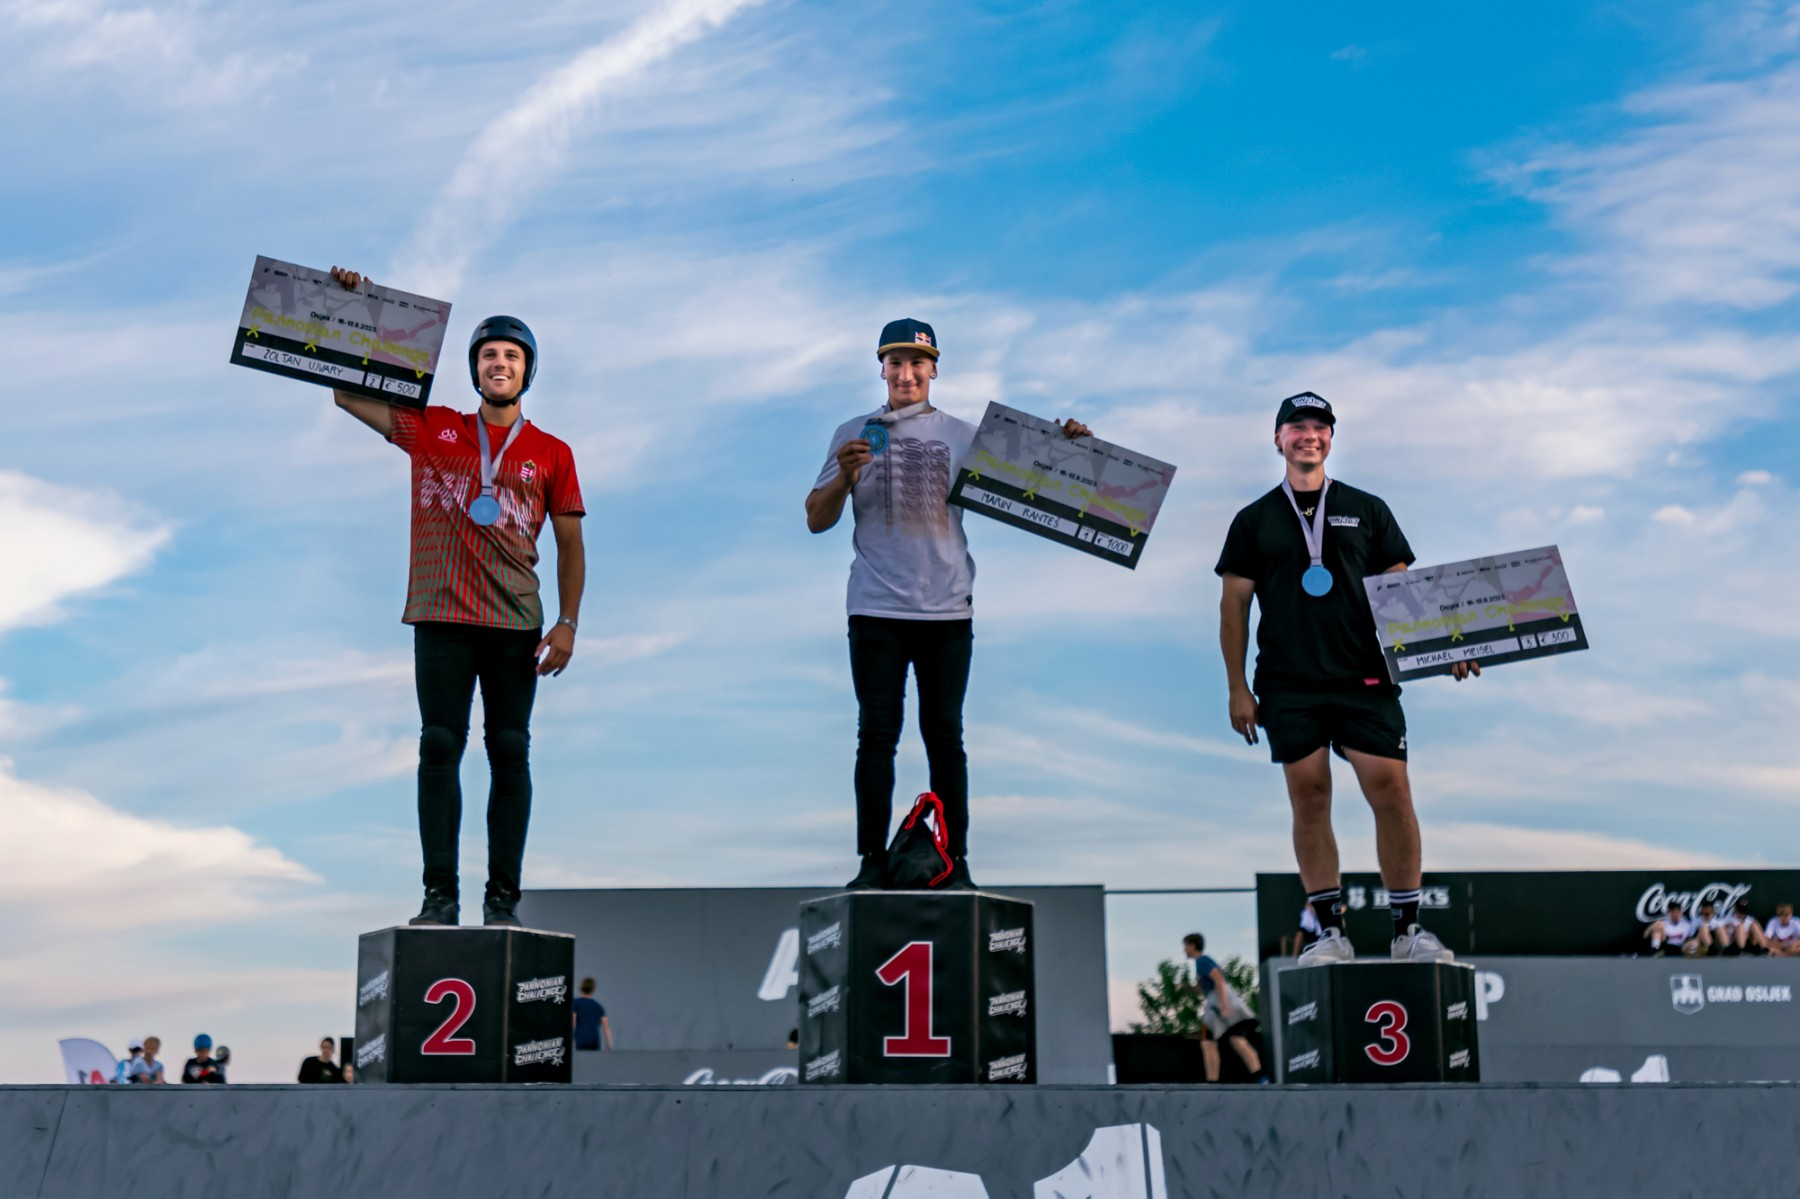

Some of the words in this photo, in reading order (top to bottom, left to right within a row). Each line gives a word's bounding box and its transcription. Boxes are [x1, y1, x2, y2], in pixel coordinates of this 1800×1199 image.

[263, 349, 302, 367] ZOLTAN
[308, 361, 344, 377] UJVARY
[369, 378, 376, 387] 2
[397, 382, 417, 396] 500
[981, 492, 1013, 511] MARIN
[1107, 538, 1129, 553] 1000
[1415, 651, 1454, 666] MICHAEL
[1463, 644, 1496, 658] MEISEL
[1635, 882, 1753, 924] Coca-Cl
[875, 941, 951, 1057] 1
[1707, 985, 1743, 1003] GRAD
[421, 977, 476, 1055] 2
[1364, 1000, 1411, 1066] 3
